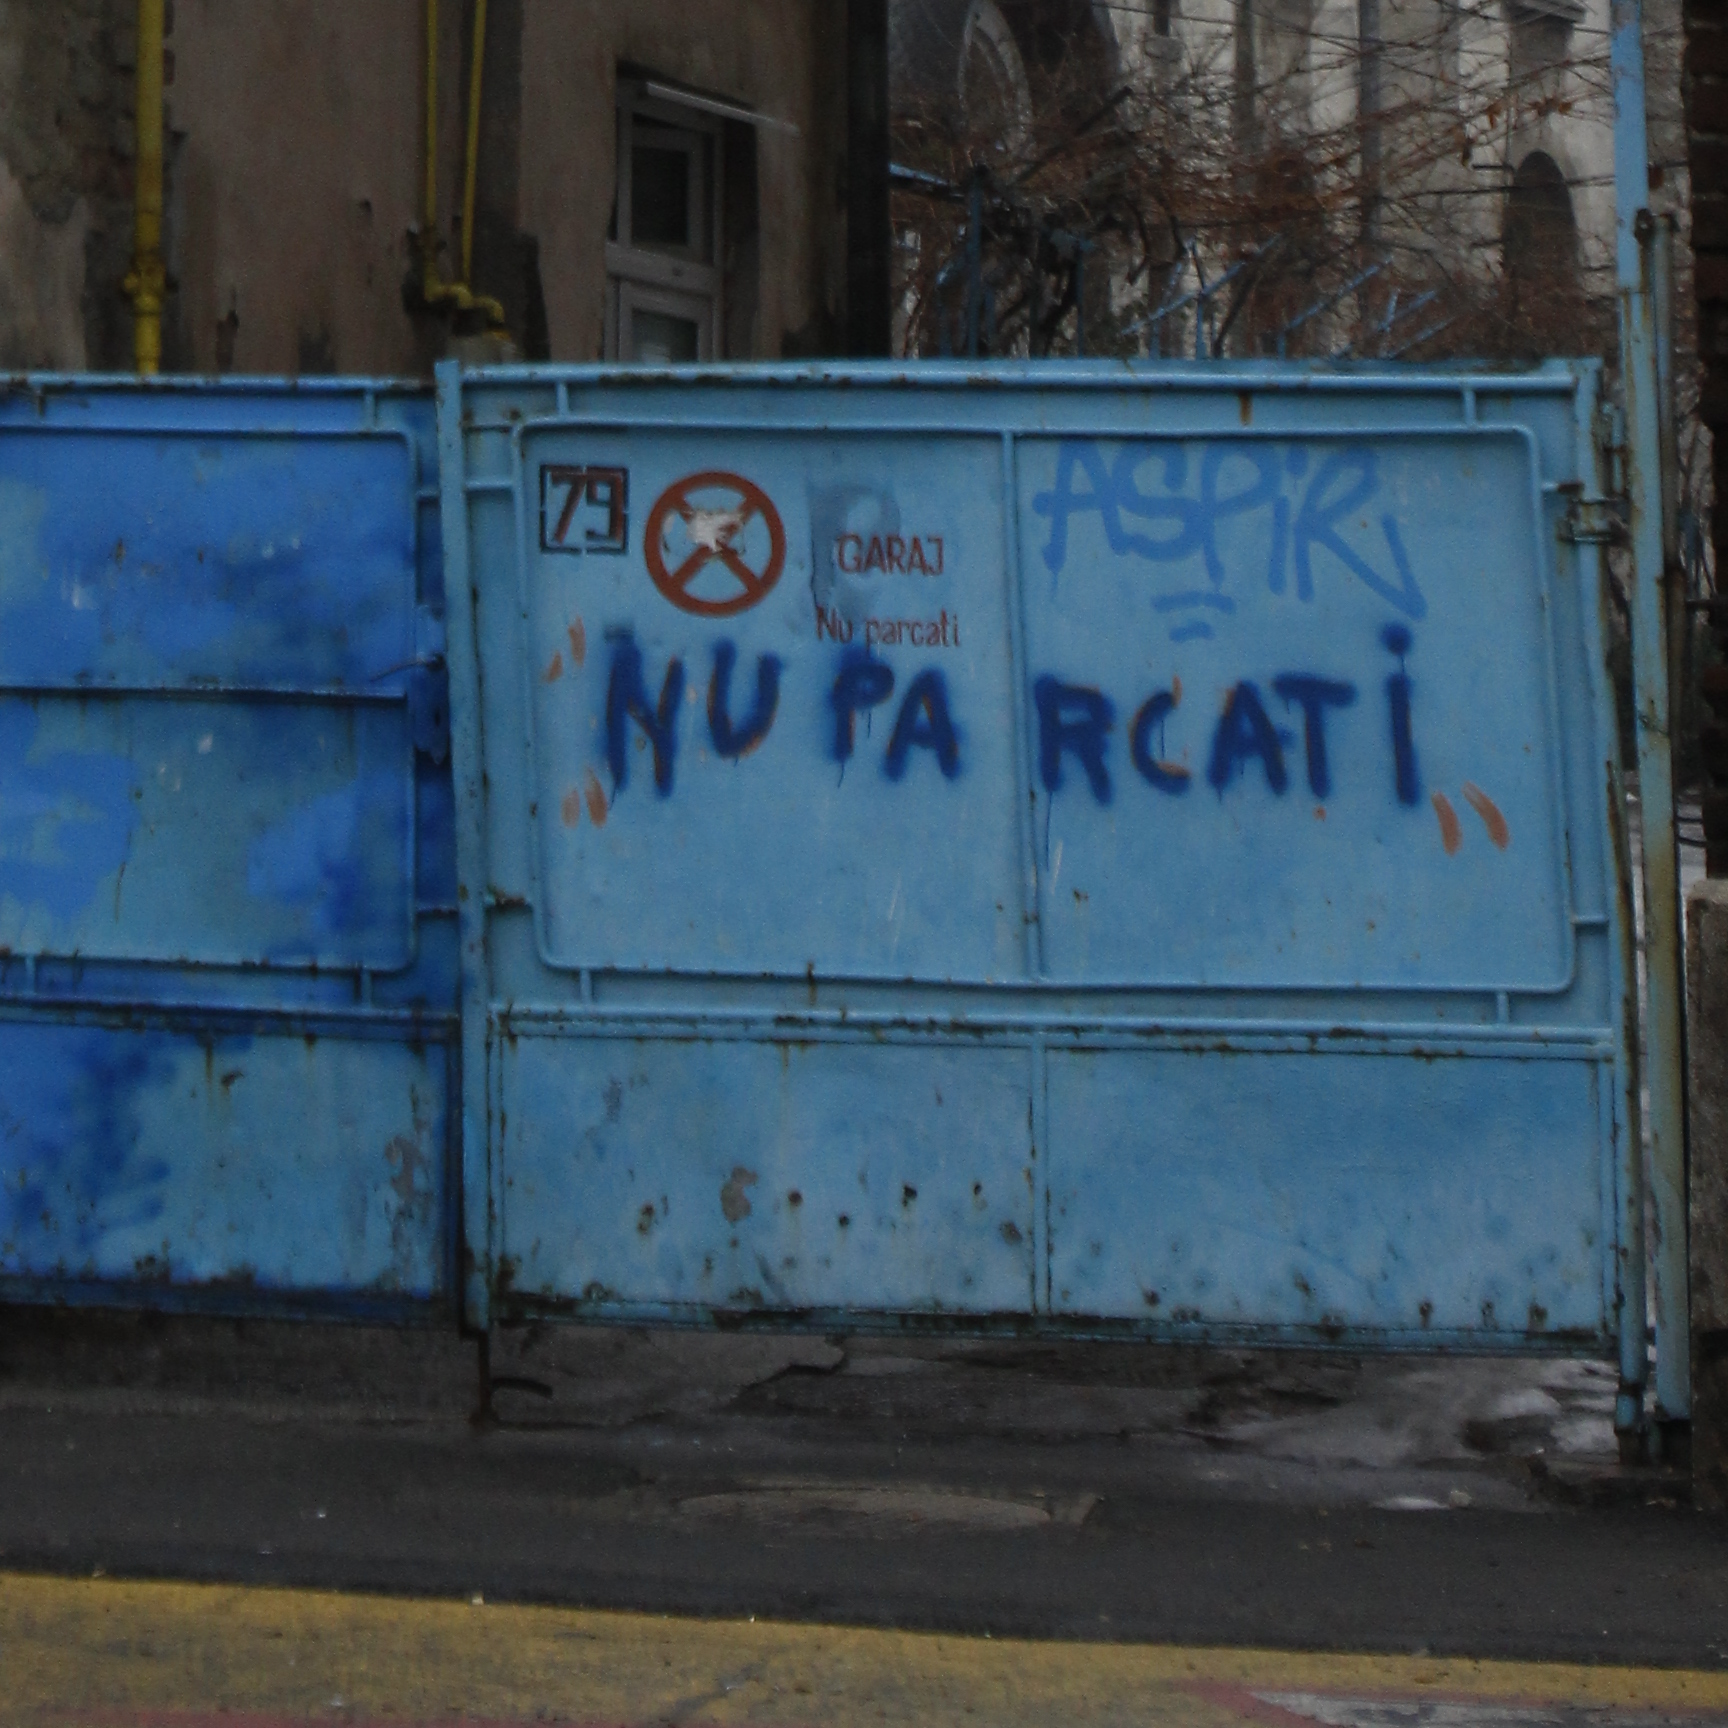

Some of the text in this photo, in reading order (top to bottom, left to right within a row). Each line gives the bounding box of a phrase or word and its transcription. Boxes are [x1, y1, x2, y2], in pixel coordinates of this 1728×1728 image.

[551, 468, 625, 544] 79
[834, 532, 945, 576] GARAJ
[816, 604, 961, 652] Nu parcati
[605, 620, 783, 800] NU
